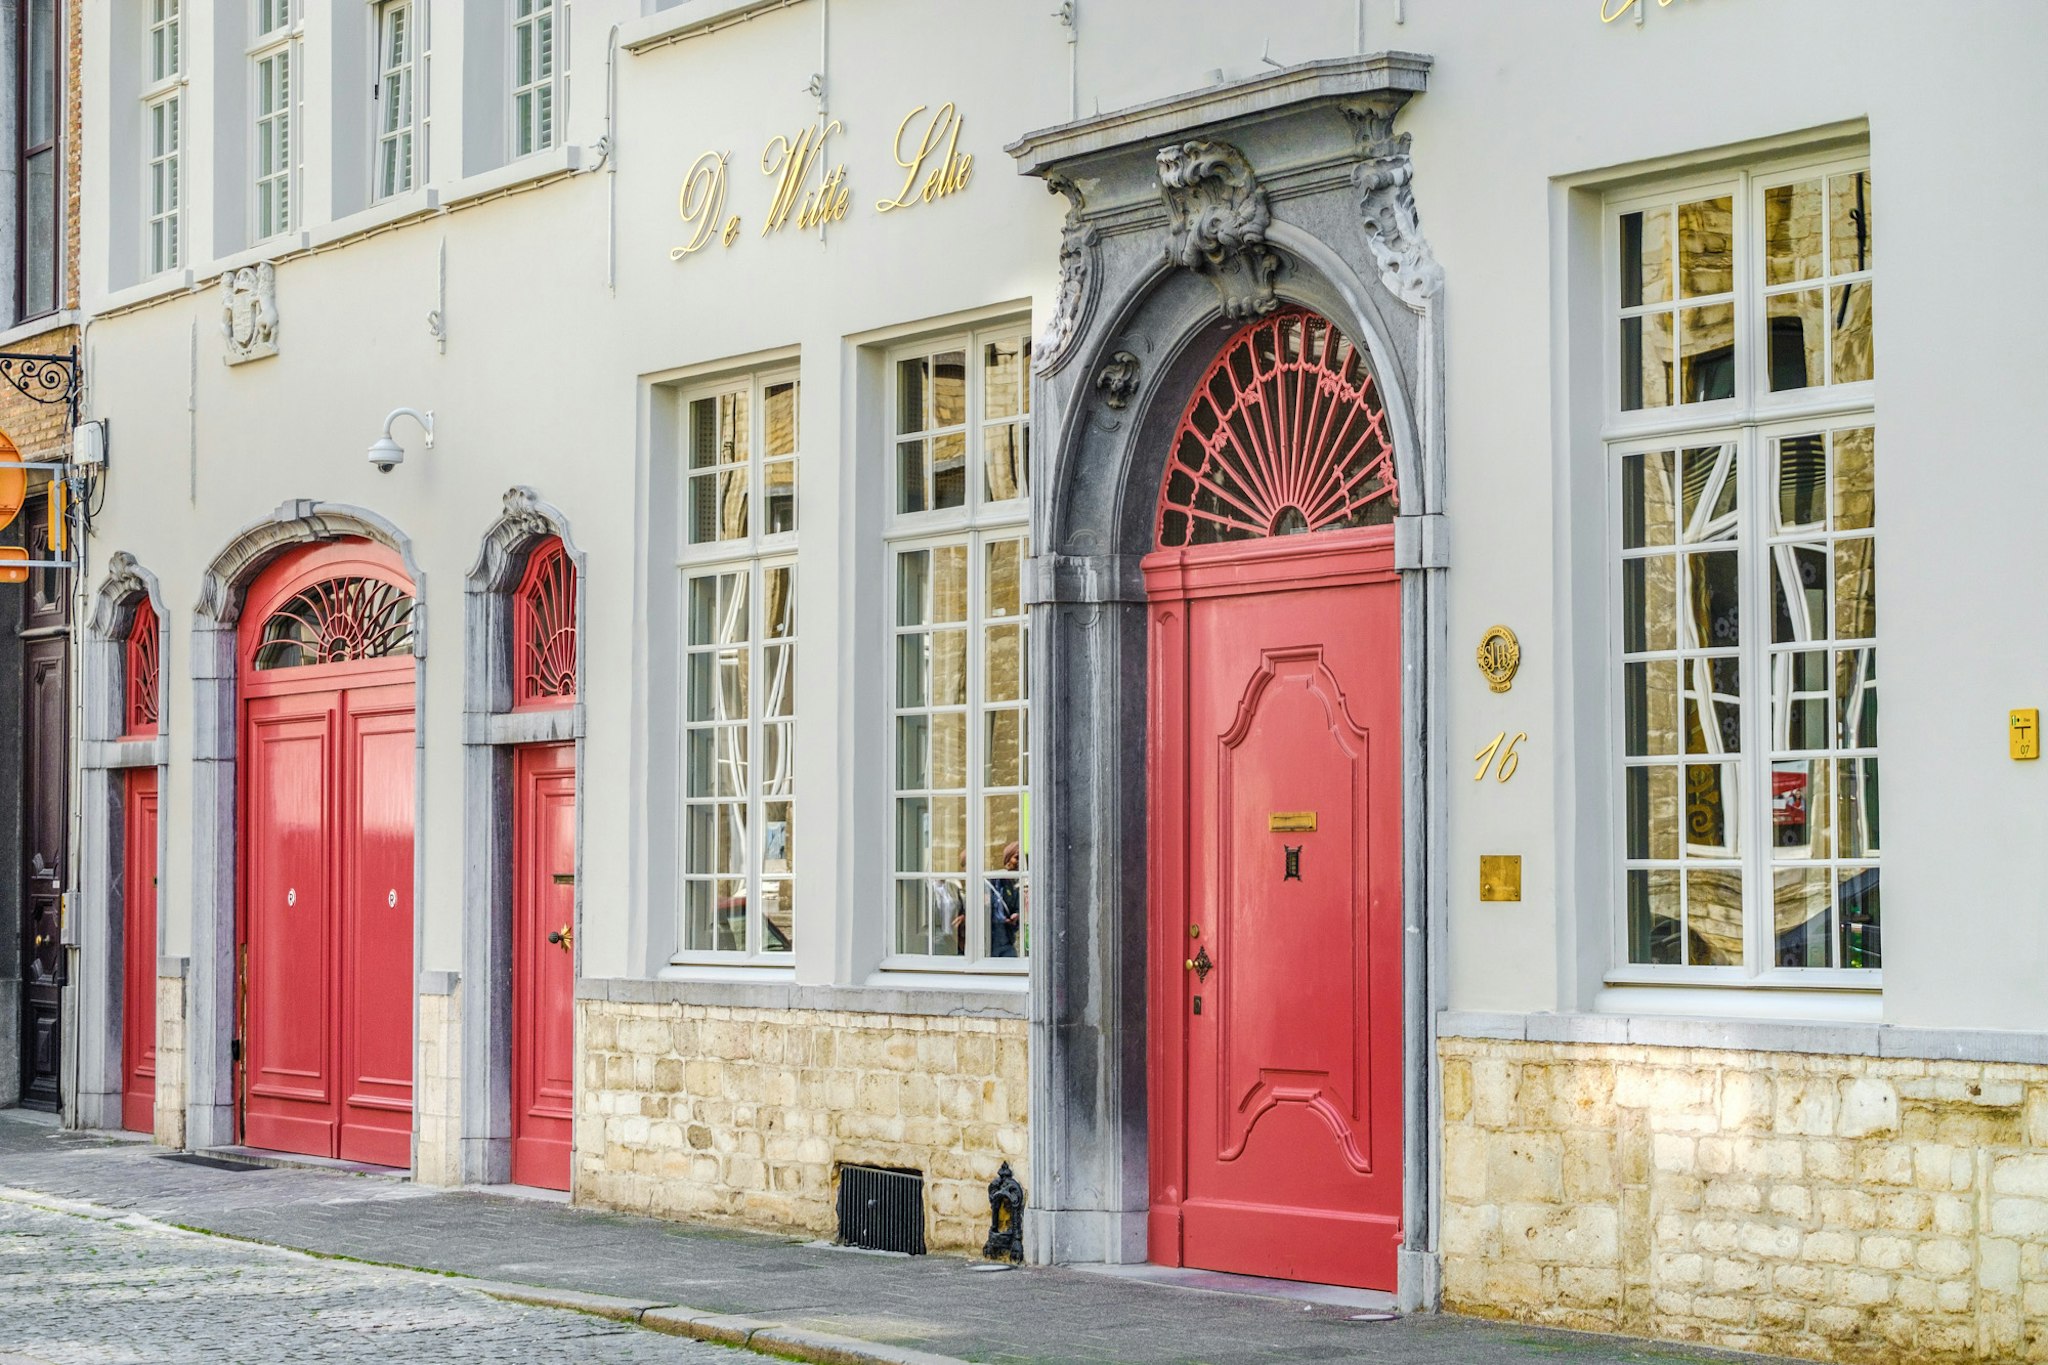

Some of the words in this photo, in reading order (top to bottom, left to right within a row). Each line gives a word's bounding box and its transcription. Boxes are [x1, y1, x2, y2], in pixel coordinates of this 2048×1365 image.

[670, 149, 741, 261] De
[761, 120, 850, 239] Witte
[875, 101, 973, 212] Lelie
[1474, 731, 1527, 783] 16
